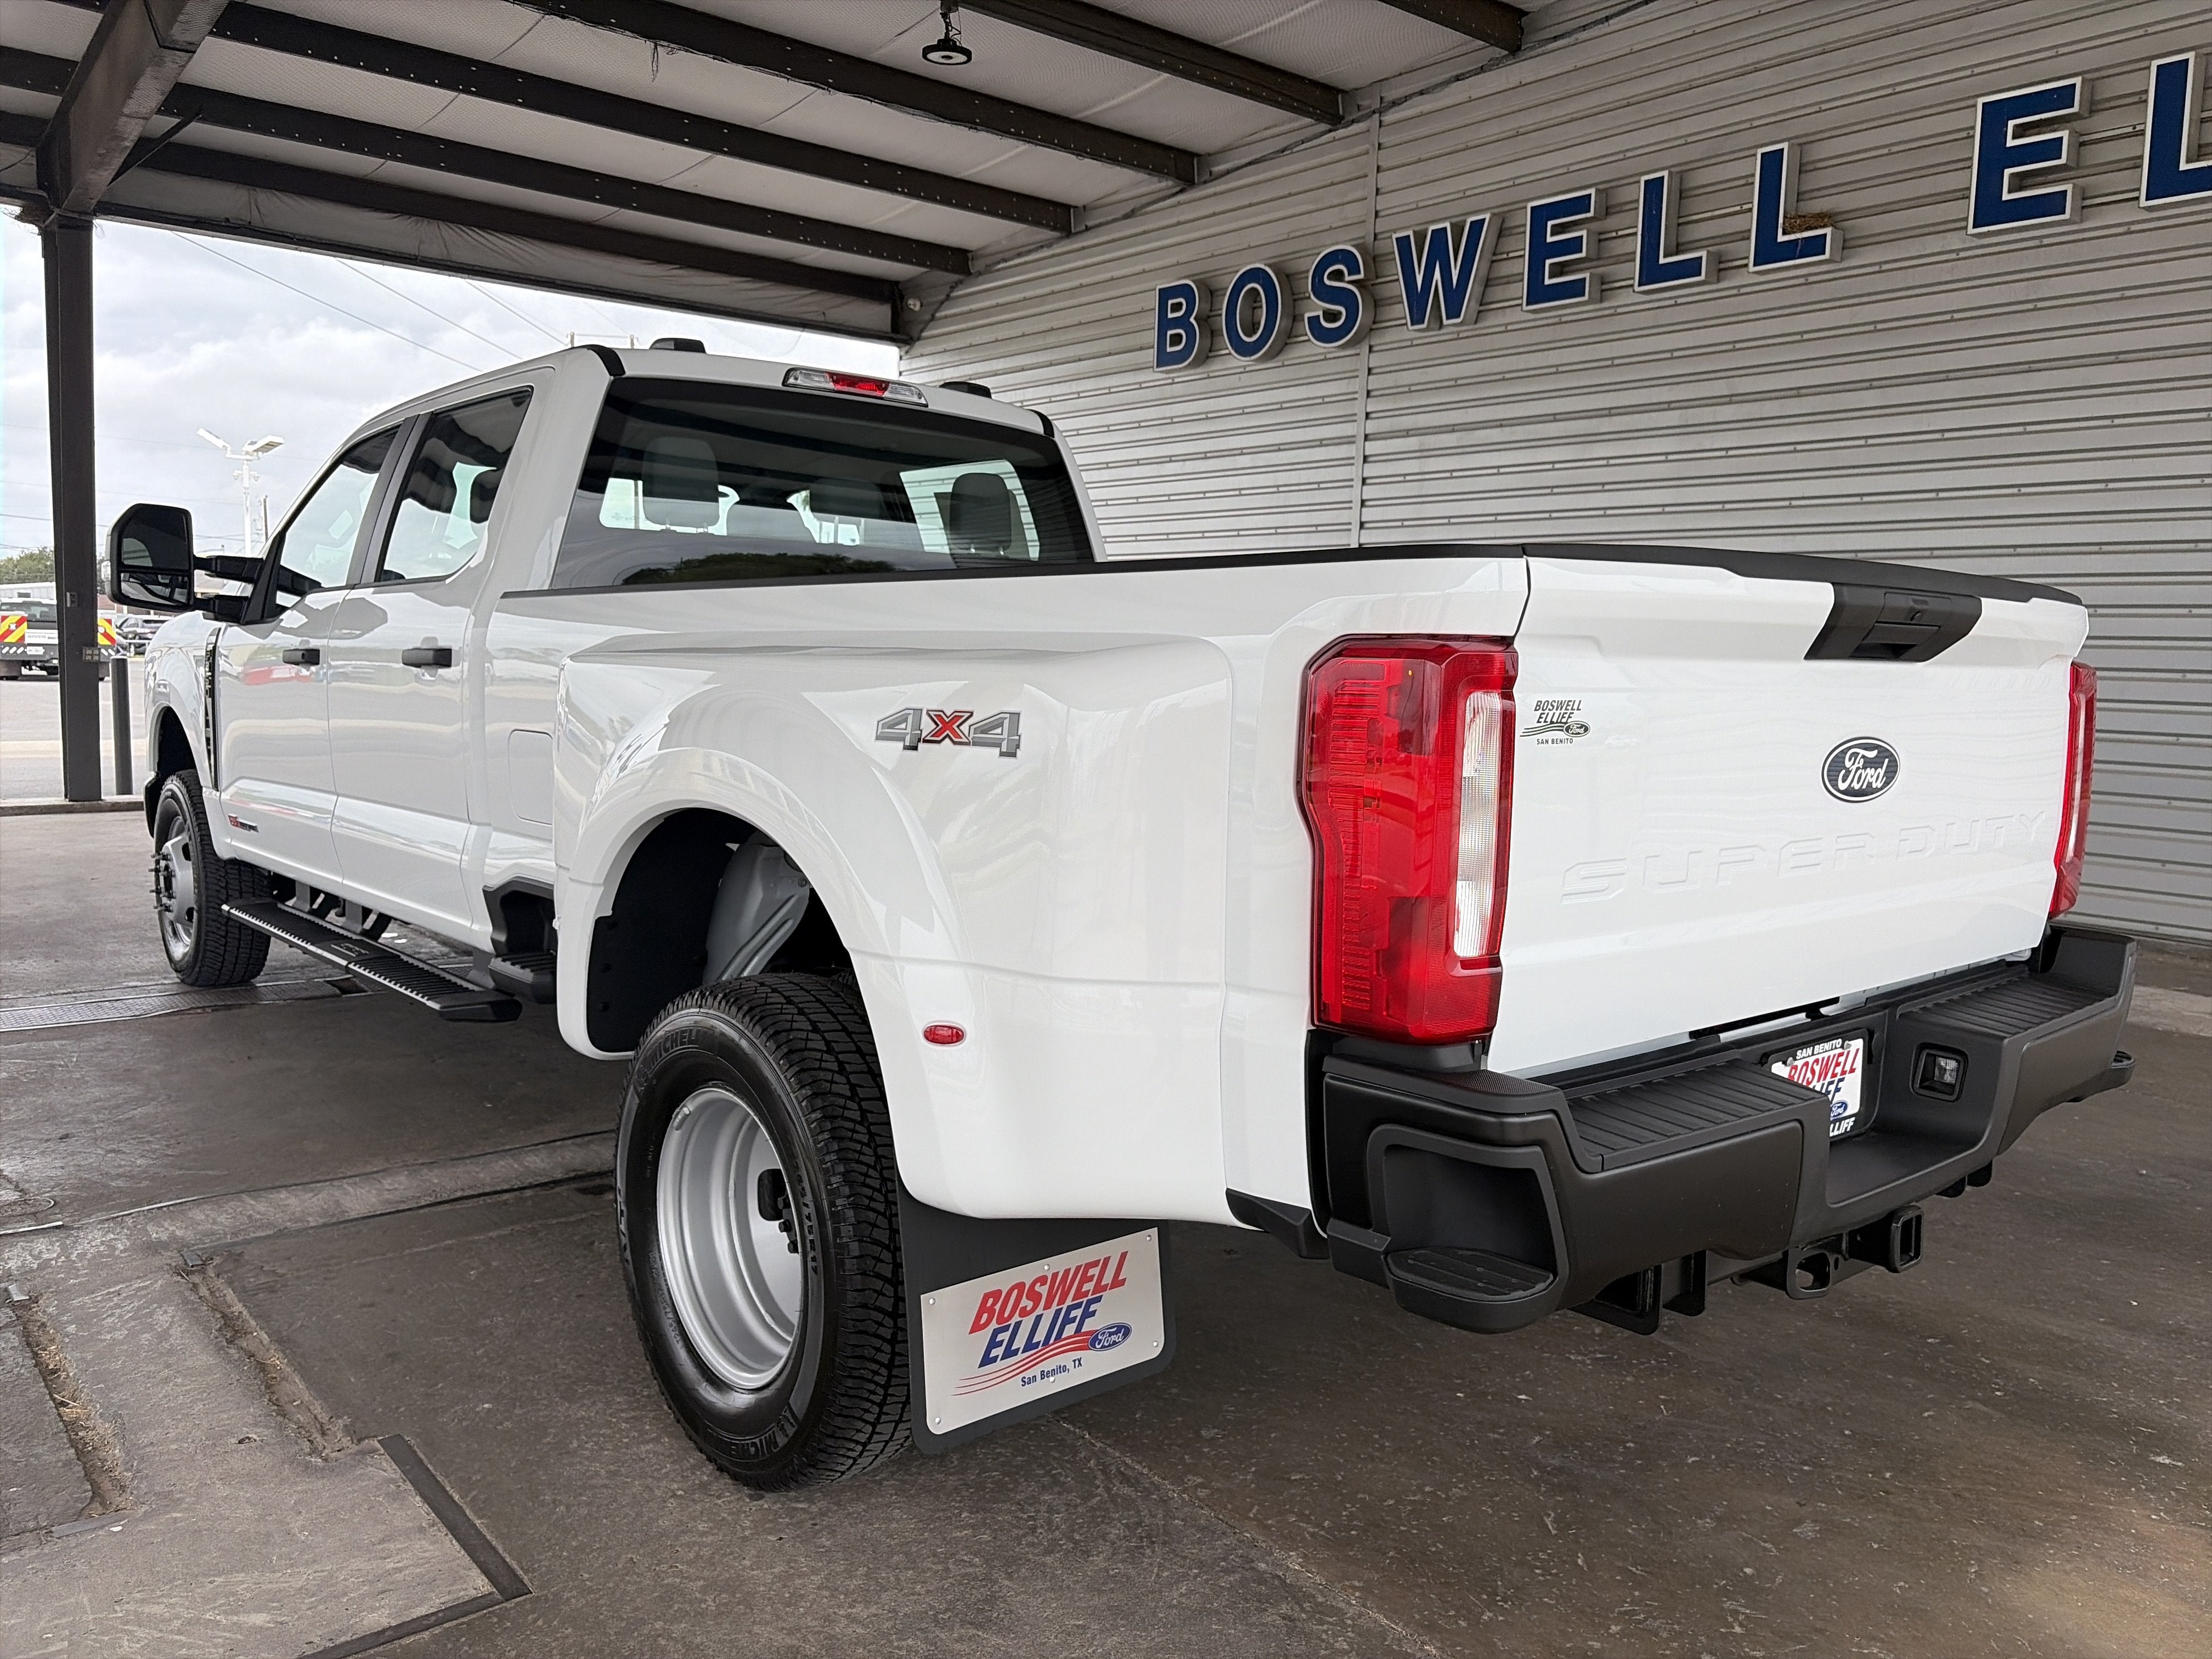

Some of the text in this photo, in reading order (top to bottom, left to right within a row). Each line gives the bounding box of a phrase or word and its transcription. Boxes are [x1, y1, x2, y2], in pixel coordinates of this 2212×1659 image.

[1154, 142, 1839, 372] BOSWELL
[1534, 699, 1582, 712] BOSWELL
[1536, 712, 1575, 724] ELLIFF
[1568, 724, 1585, 734] Ford
[1838, 748, 1888, 791] Ford
[1561, 810, 2047, 905] SUPER DUTY
[646, 1027, 712, 1069] MICHEL
[1796, 1039, 1842, 1059] SAN BENITO
[1788, 1048, 1860, 1087] BOSWELL
[1830, 1117, 1855, 1137] LLIFF
[969, 1251, 1128, 1335] BOSWELL
[978, 1295, 1103, 1369] ELLIFF
[1094, 1327, 1125, 1347] Ford
[1021, 1357, 1082, 1387] San Benito, TX
